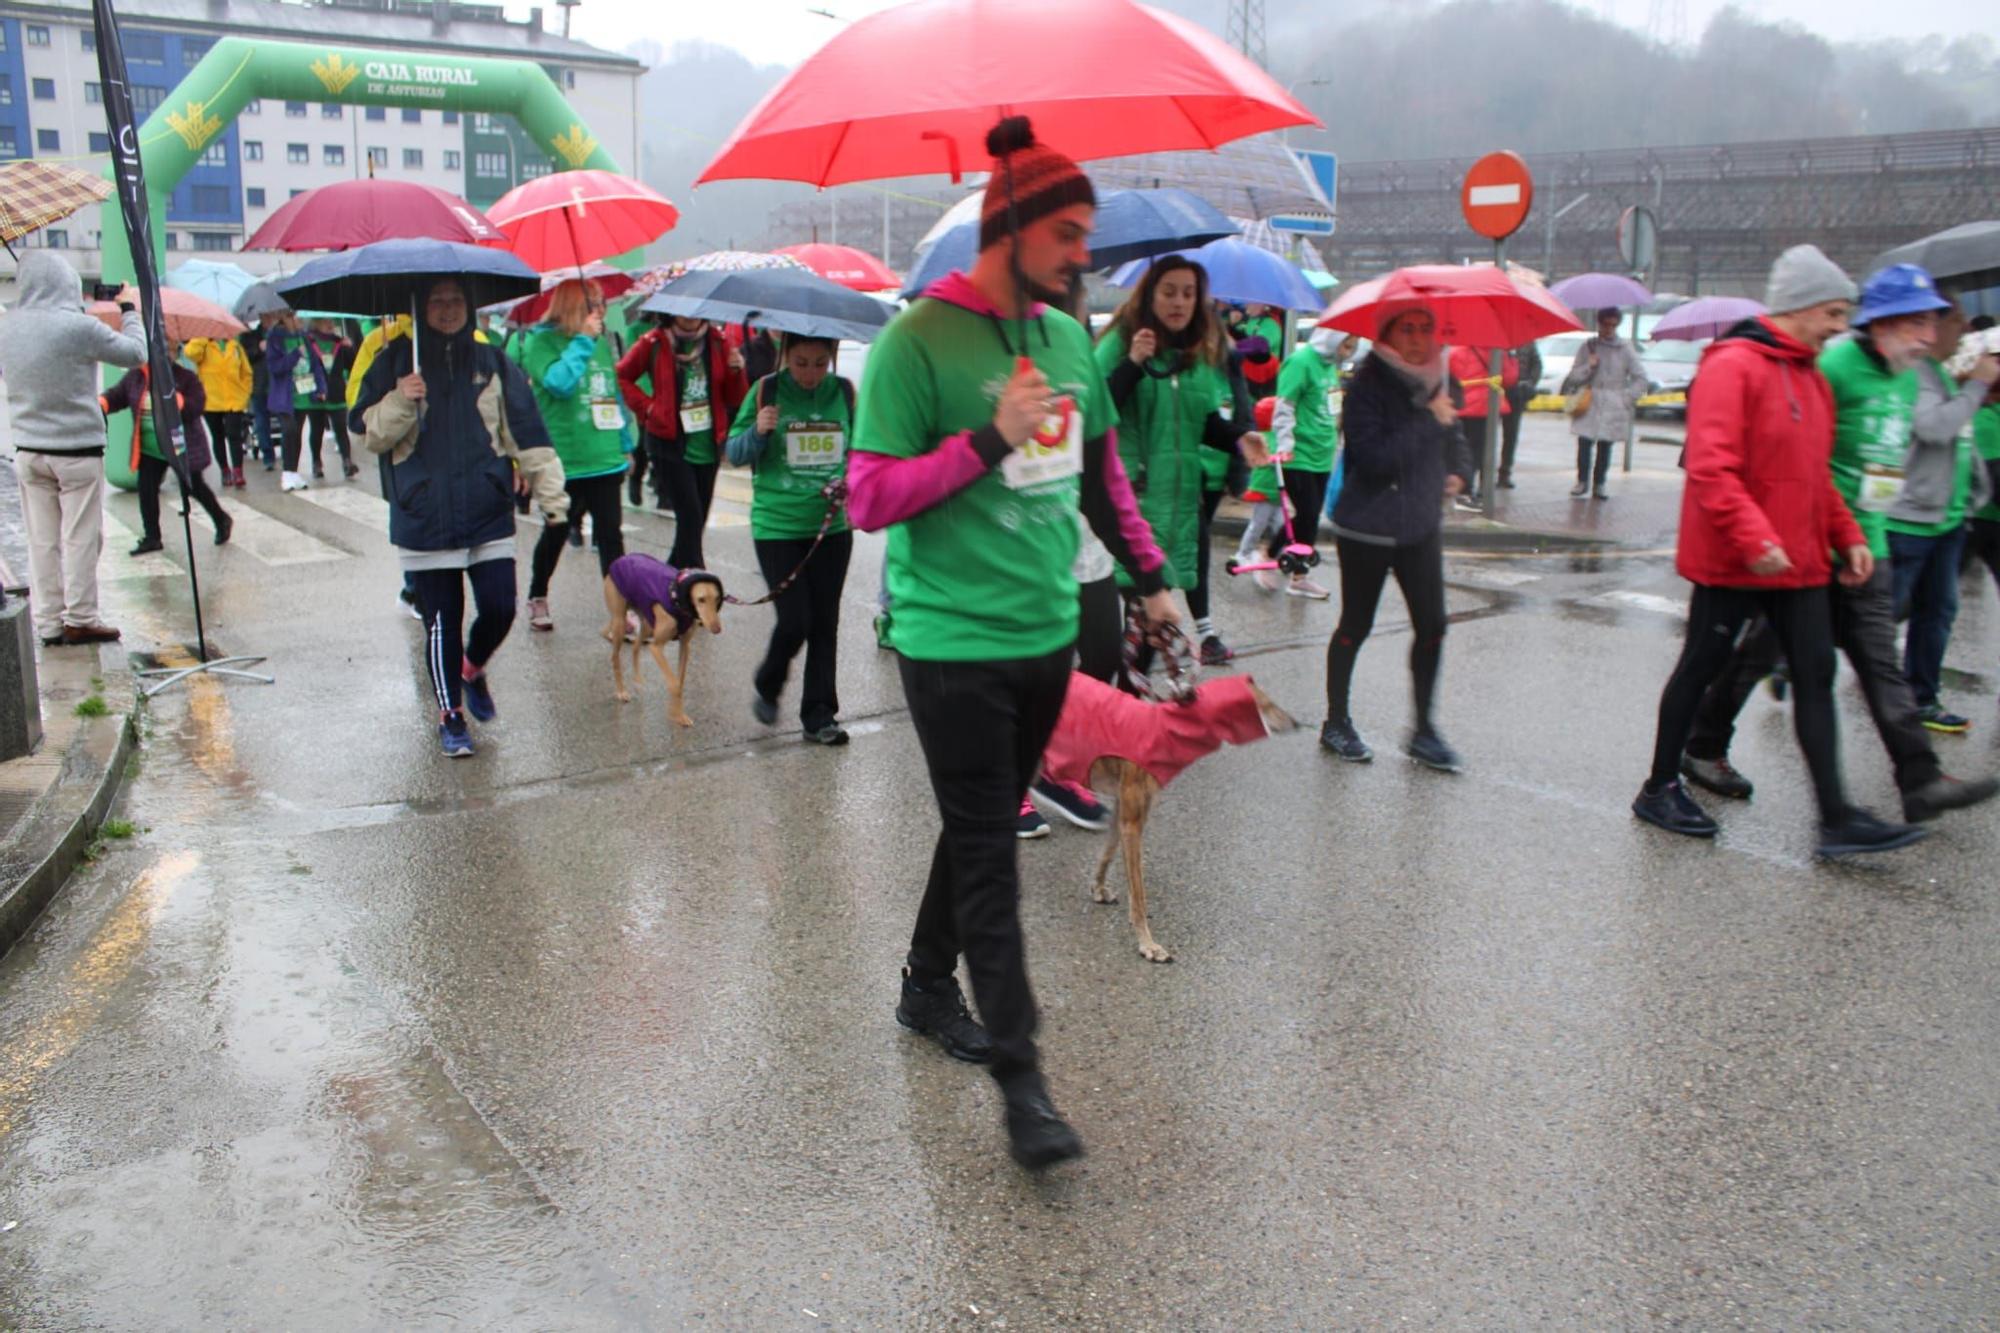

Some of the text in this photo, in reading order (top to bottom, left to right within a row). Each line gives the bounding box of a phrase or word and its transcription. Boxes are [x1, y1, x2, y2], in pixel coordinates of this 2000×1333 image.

[365, 62, 478, 86] CAJA RURAL
[367, 83, 385, 95] DE
[797, 434, 835, 453] 186
